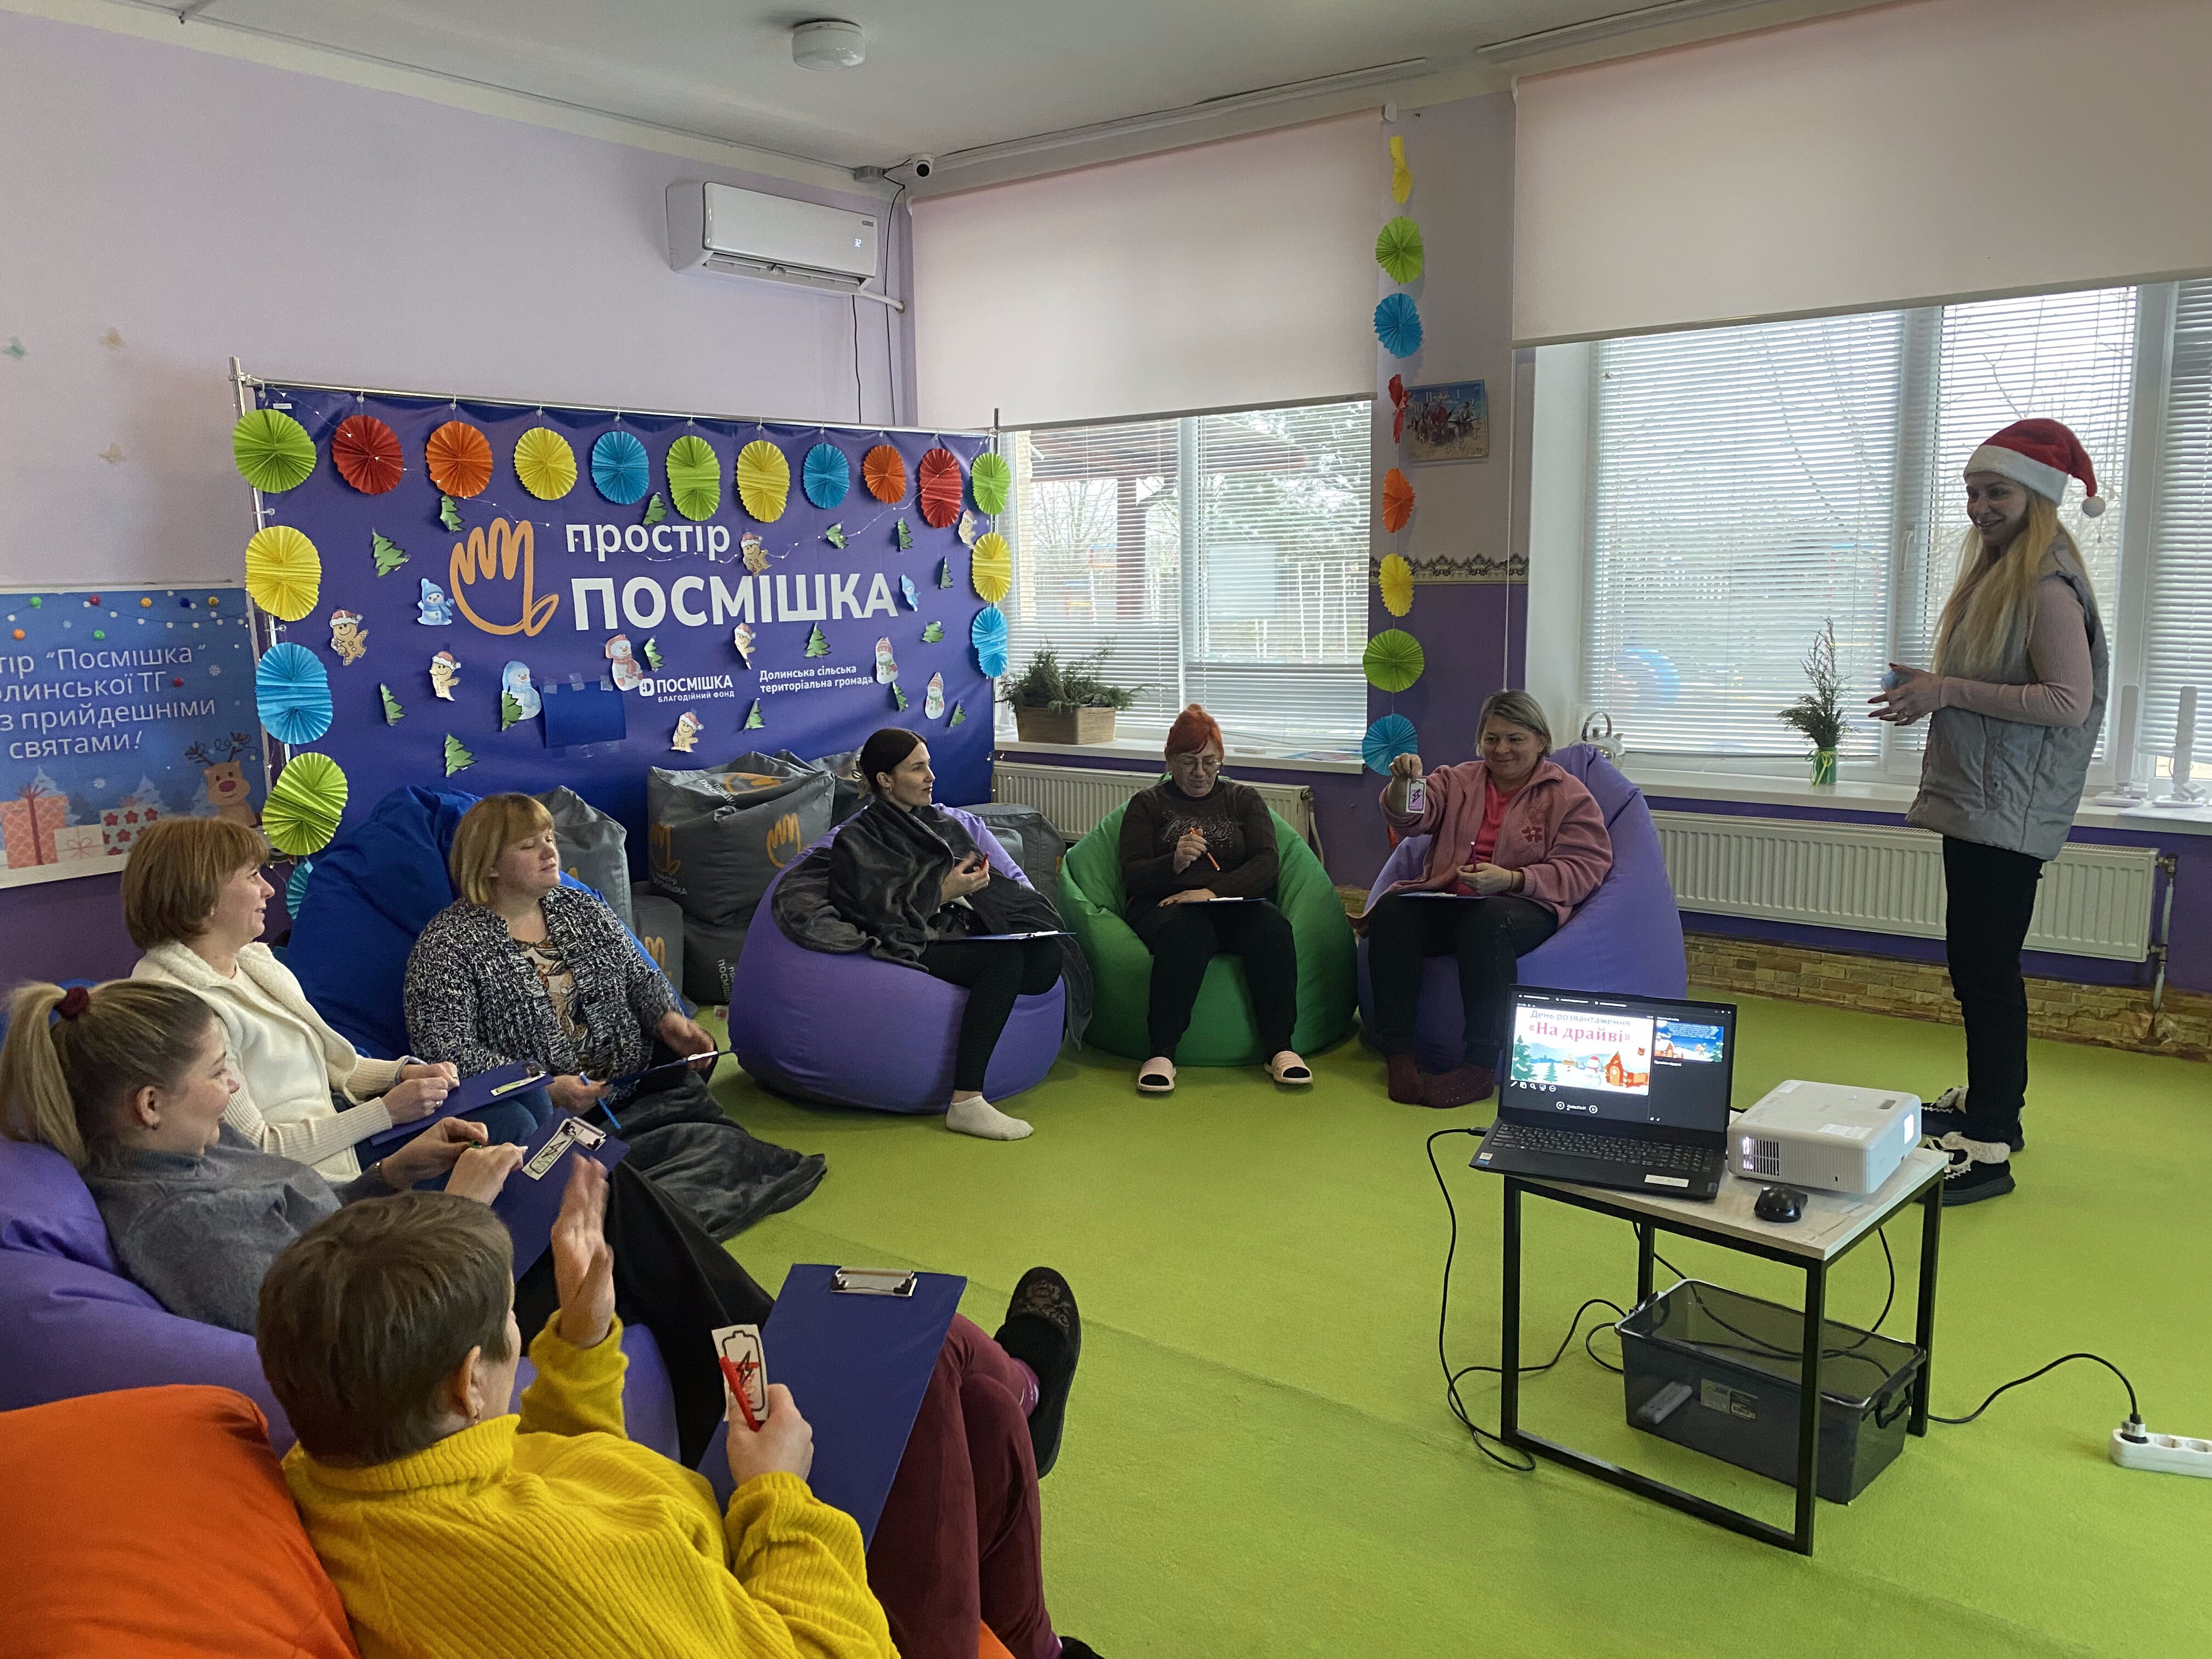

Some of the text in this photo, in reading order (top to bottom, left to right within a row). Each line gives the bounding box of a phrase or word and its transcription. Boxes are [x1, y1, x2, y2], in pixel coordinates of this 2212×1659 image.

[566, 524, 730, 562] простір
[571, 573, 899, 630] ПОСМІШКА
[657, 674, 733, 693] ПОСМІШКА
[759, 665, 857, 682] Долинська сільська
[0, 671, 167, 702] линської ТГ
[760, 676, 874, 694] територіальна громада
[658, 692, 712, 703] БЛАГОДІЙНИЙ
[21, 699, 215, 735] прийдешніми
[9, 730, 143, 759] святами!
[1530, 1009, 1631, 1026] День розвантаження
[1528, 1021, 1631, 1042] «На драйві»
